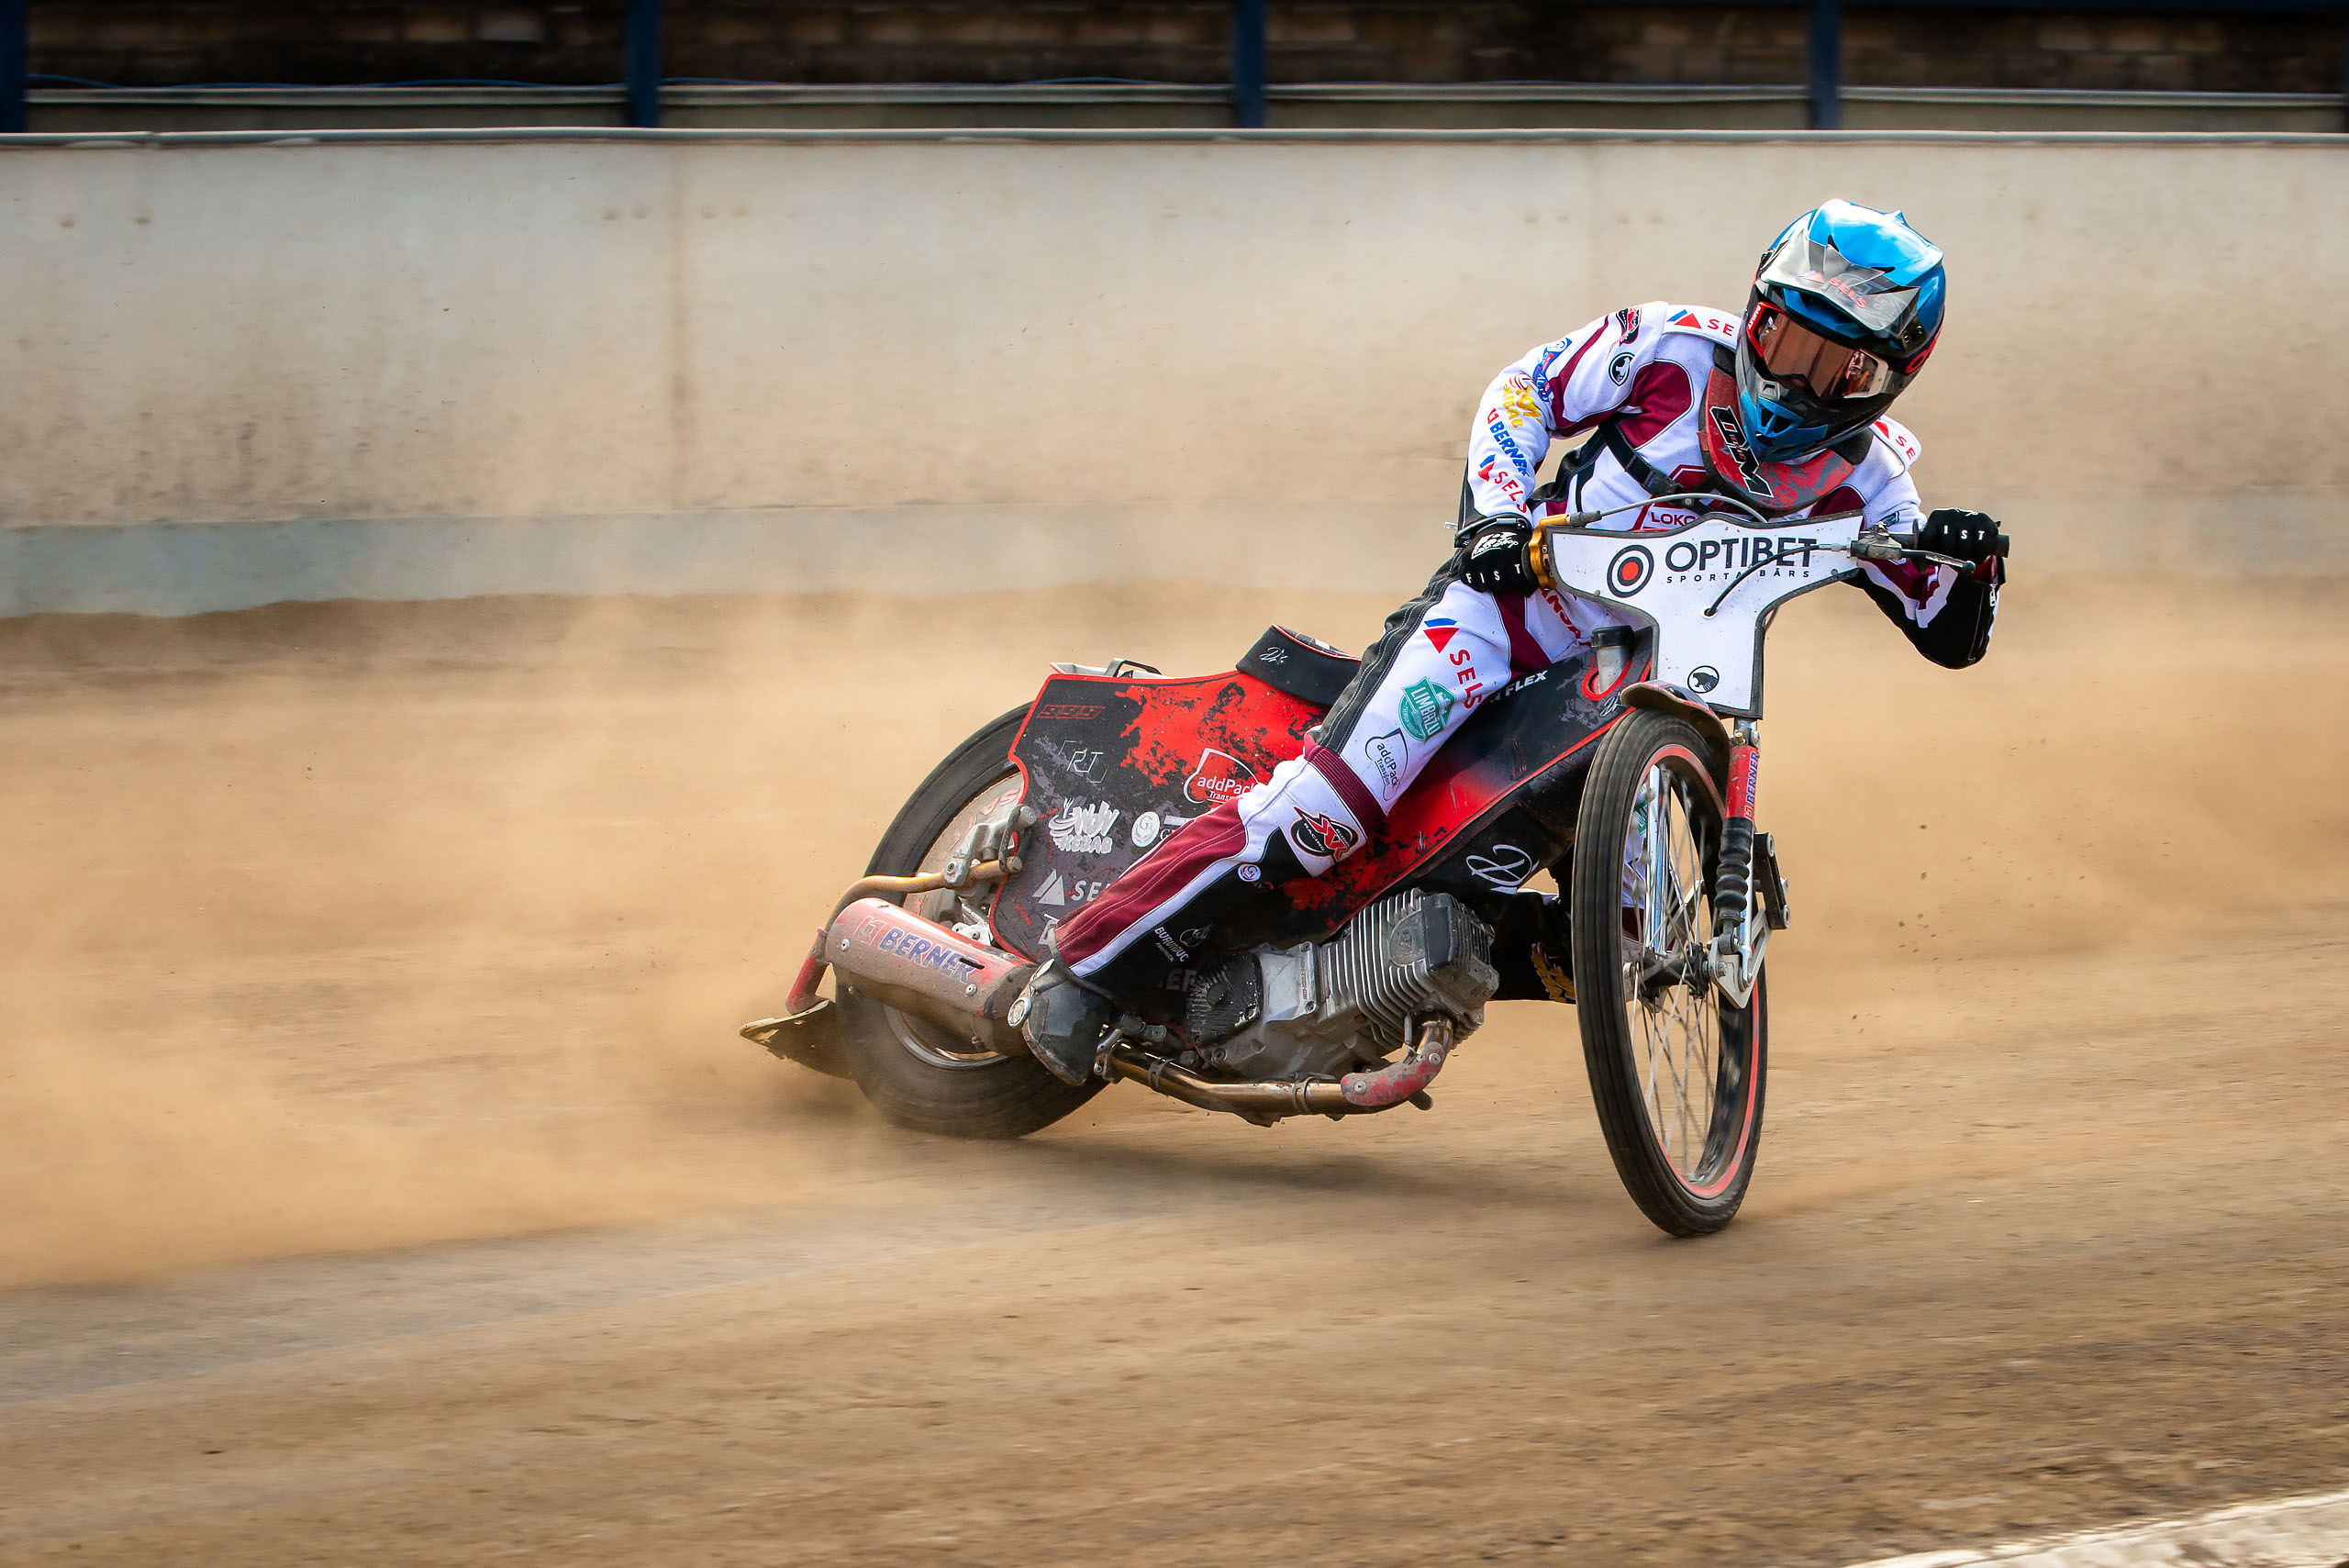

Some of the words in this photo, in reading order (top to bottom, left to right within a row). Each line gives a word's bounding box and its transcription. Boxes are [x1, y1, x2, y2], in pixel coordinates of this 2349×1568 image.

[1828, 277, 1867, 308] SELS
[1494, 471, 1528, 514] SELS
[1664, 537, 1818, 573] OPTIBET
[1666, 571, 1742, 584] SPORTA
[1759, 567, 1810, 578] BĀRS
[1450, 649, 1484, 709] SELS
[1745, 751, 1759, 806] BERNER
[878, 924, 983, 984] BERNER
